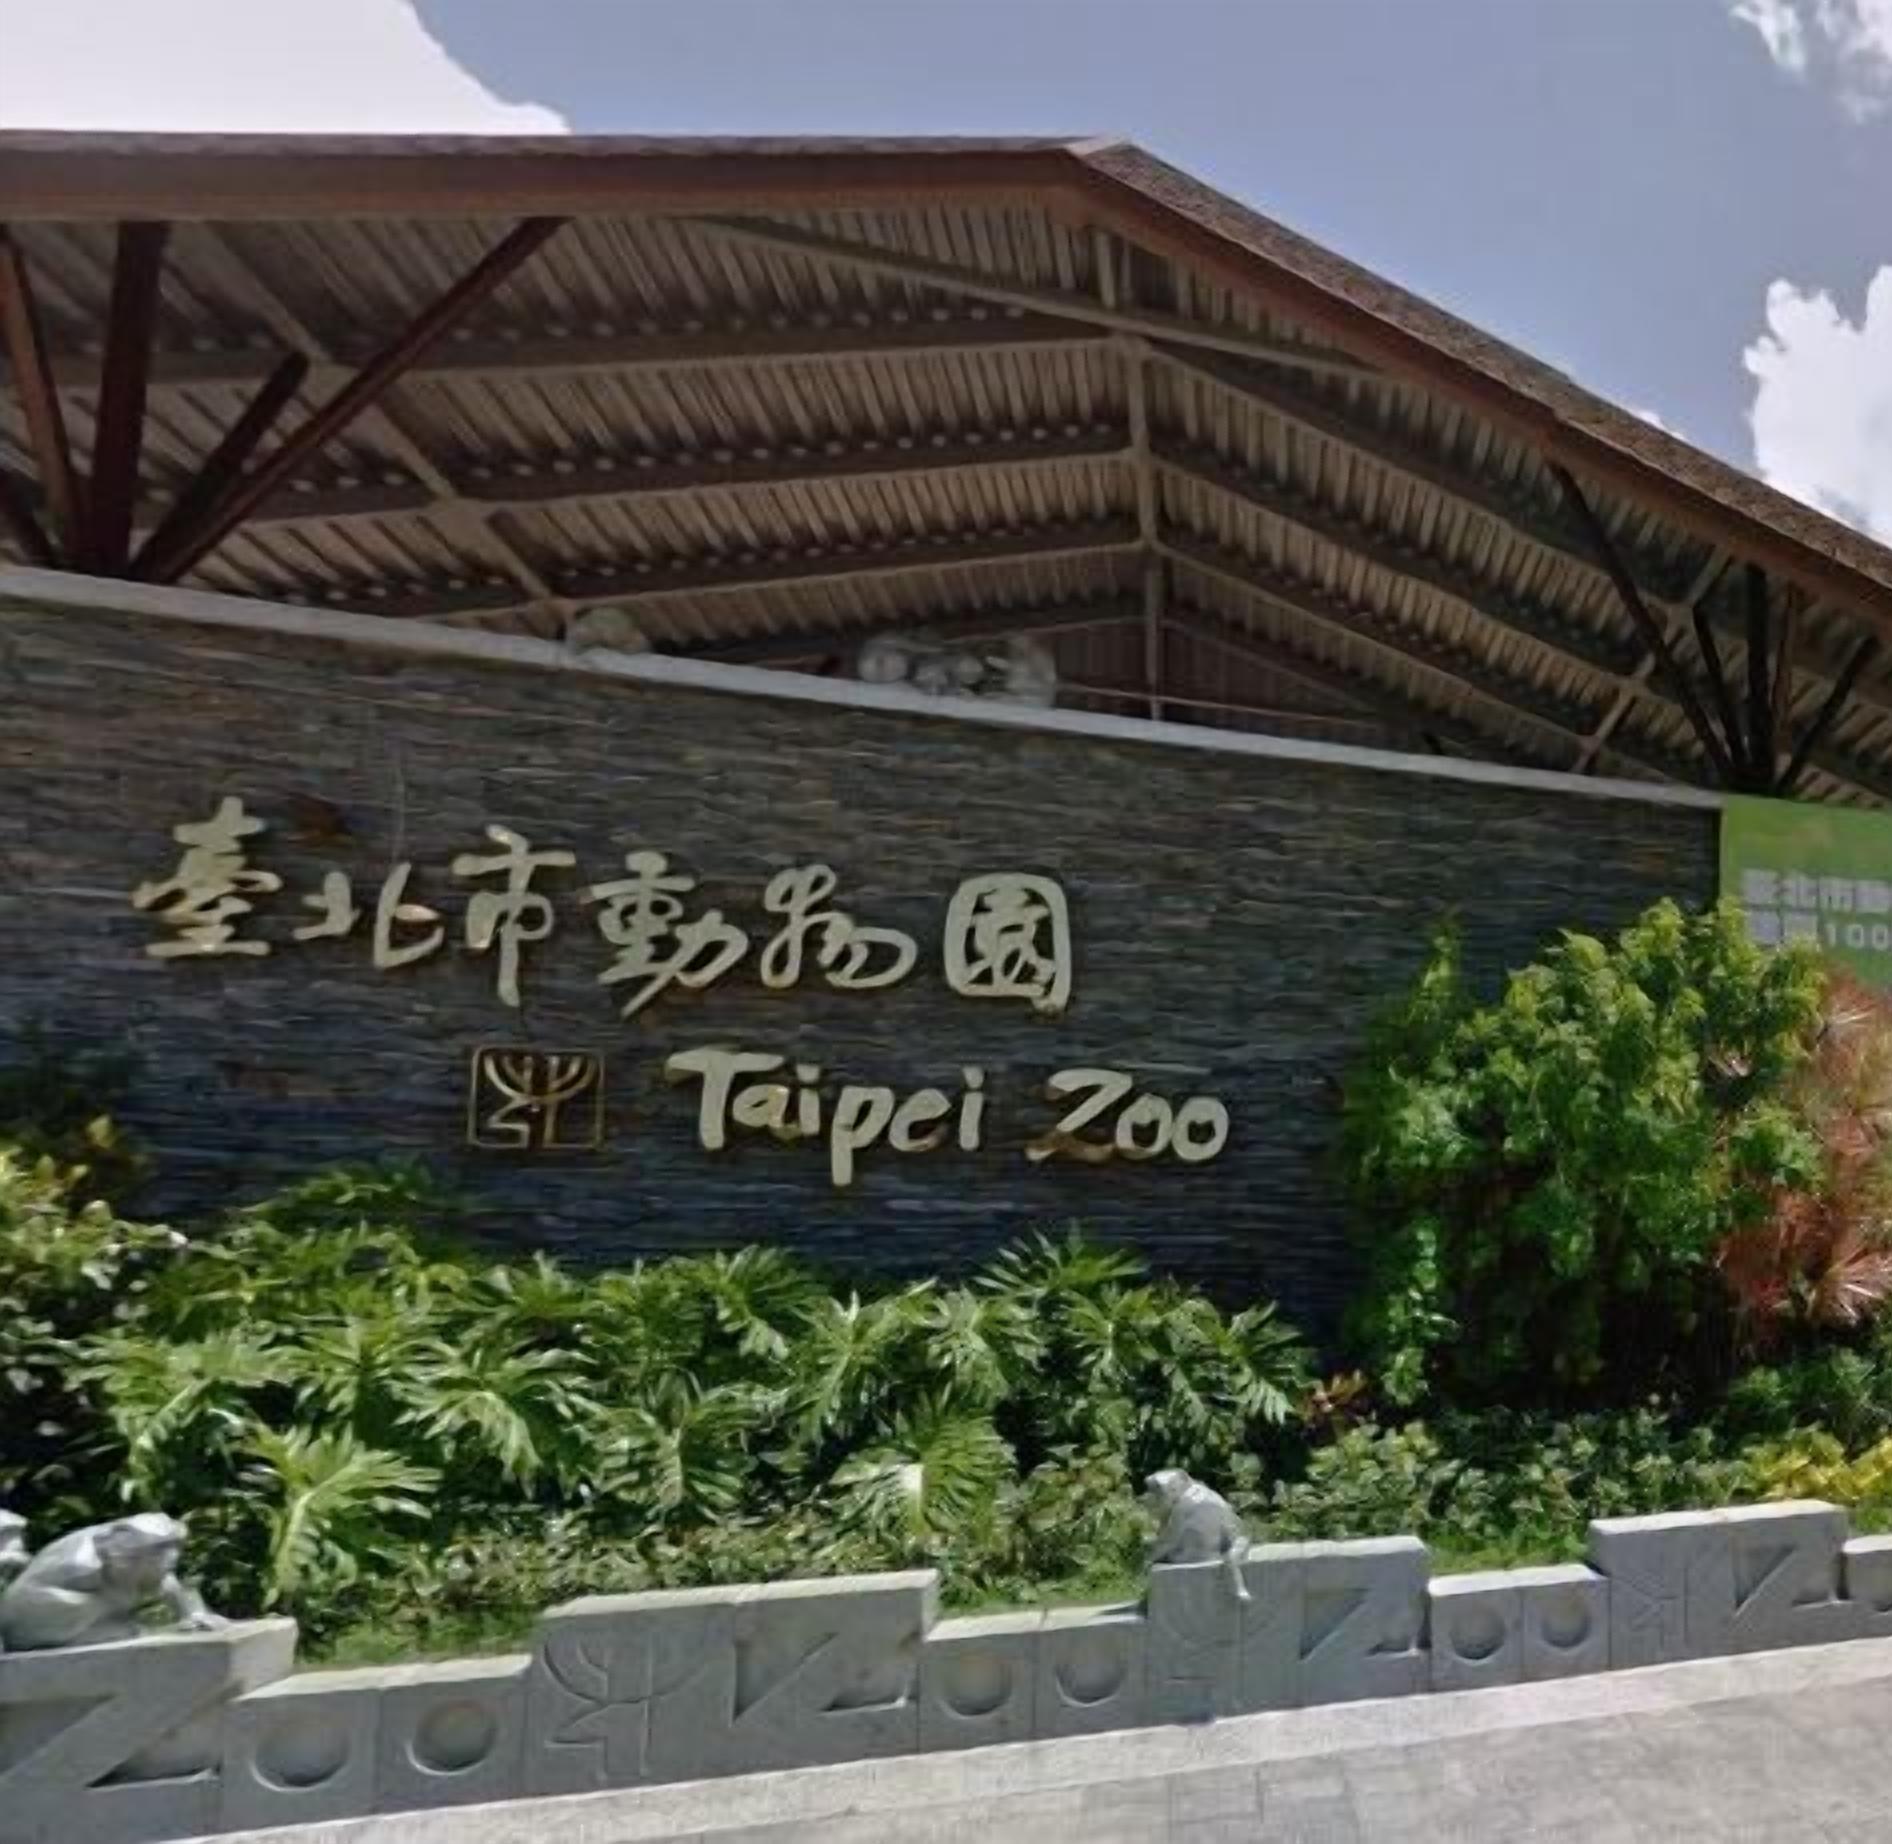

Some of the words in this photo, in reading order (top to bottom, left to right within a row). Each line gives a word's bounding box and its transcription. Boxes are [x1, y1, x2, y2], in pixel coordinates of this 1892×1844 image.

[131, 797, 1072, 1018] 臺北市動物園
[664, 1047, 985, 1186] Taipei
[1025, 1068, 1229, 1162] Zoo
